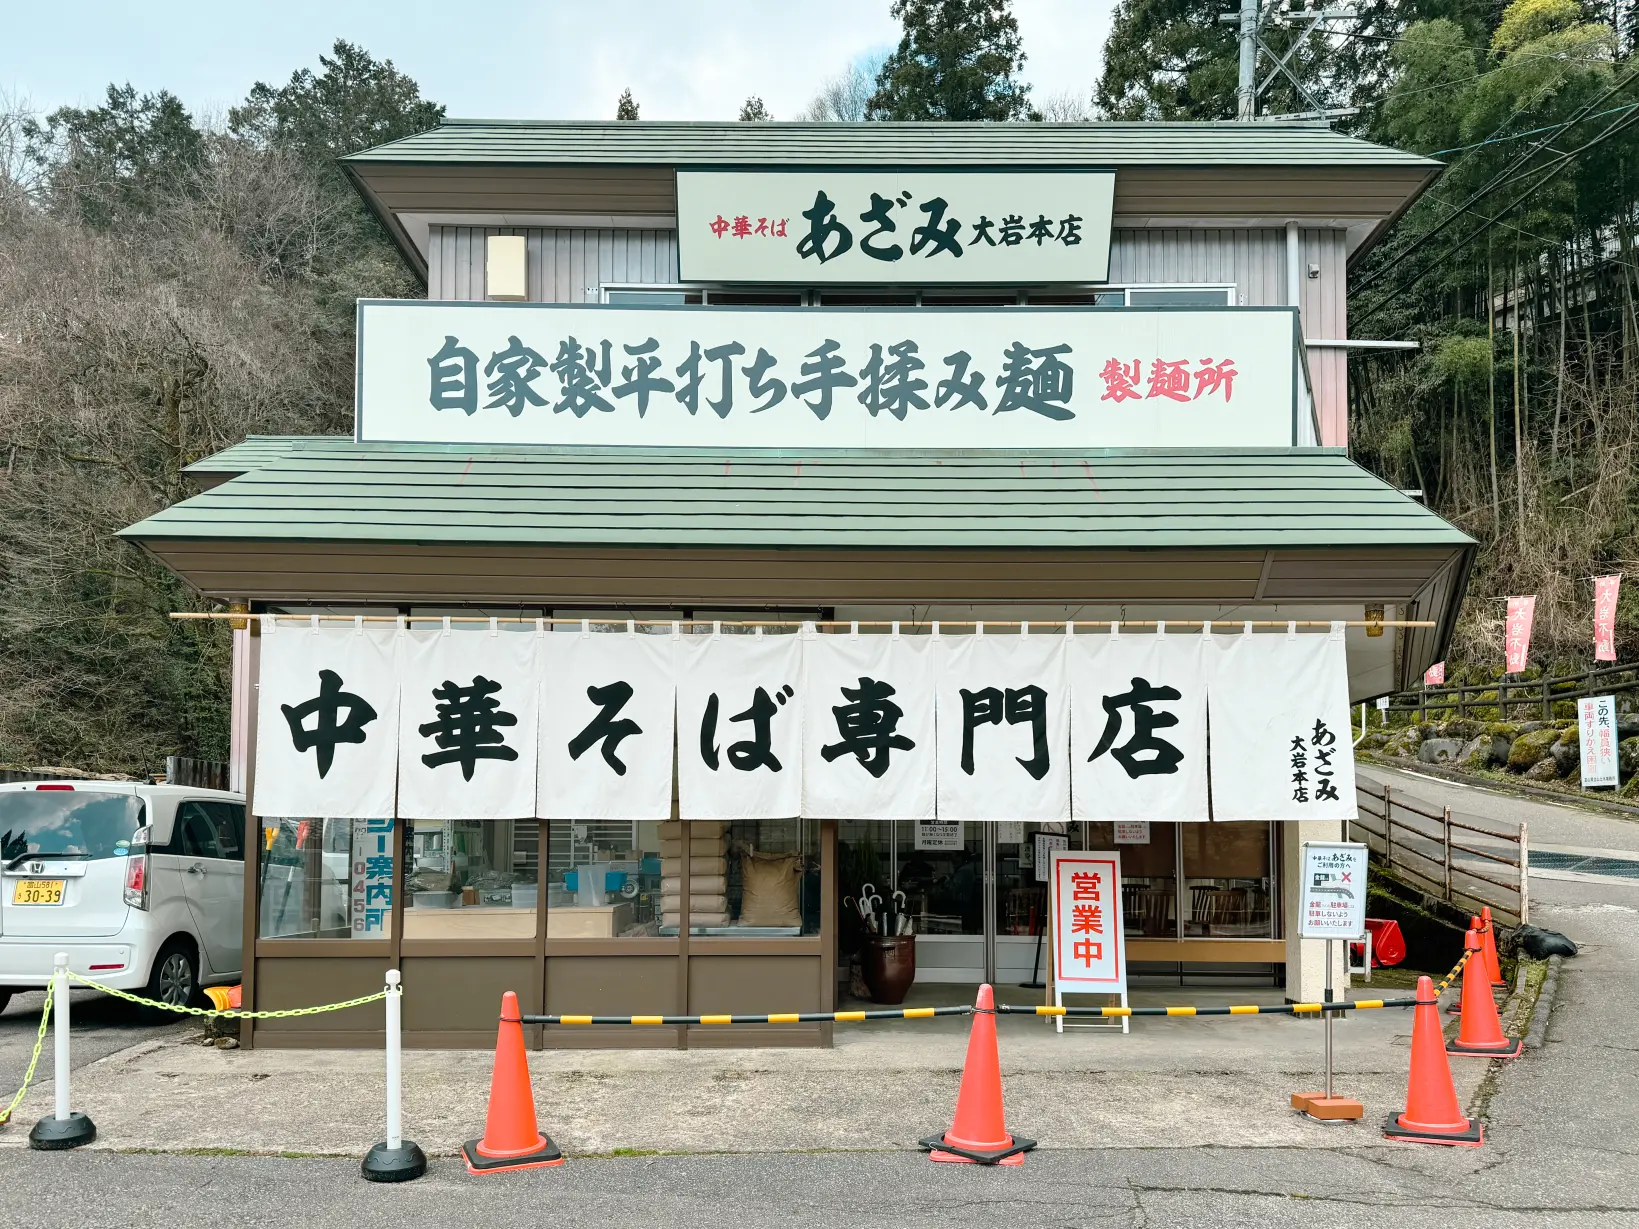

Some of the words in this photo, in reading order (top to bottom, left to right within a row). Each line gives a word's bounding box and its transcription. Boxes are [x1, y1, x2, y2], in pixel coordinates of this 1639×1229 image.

[709, 215, 789, 240] 中華そば
[796, 190, 964, 265] あざみ
[967, 213, 1084, 248] 大岩本店
[427, 335, 1076, 422] 自家製平打ち手揉み麺
[1098, 357, 1238, 404] 製麺所
[280, 669, 1185, 782] 中華そば専門店
[1311, 718, 1340, 801] あざみ
[1289, 735, 1309, 803] 大岩本店
[23, 889, 61, 903] 30-39
[1071, 872, 1104, 968] 営業中
